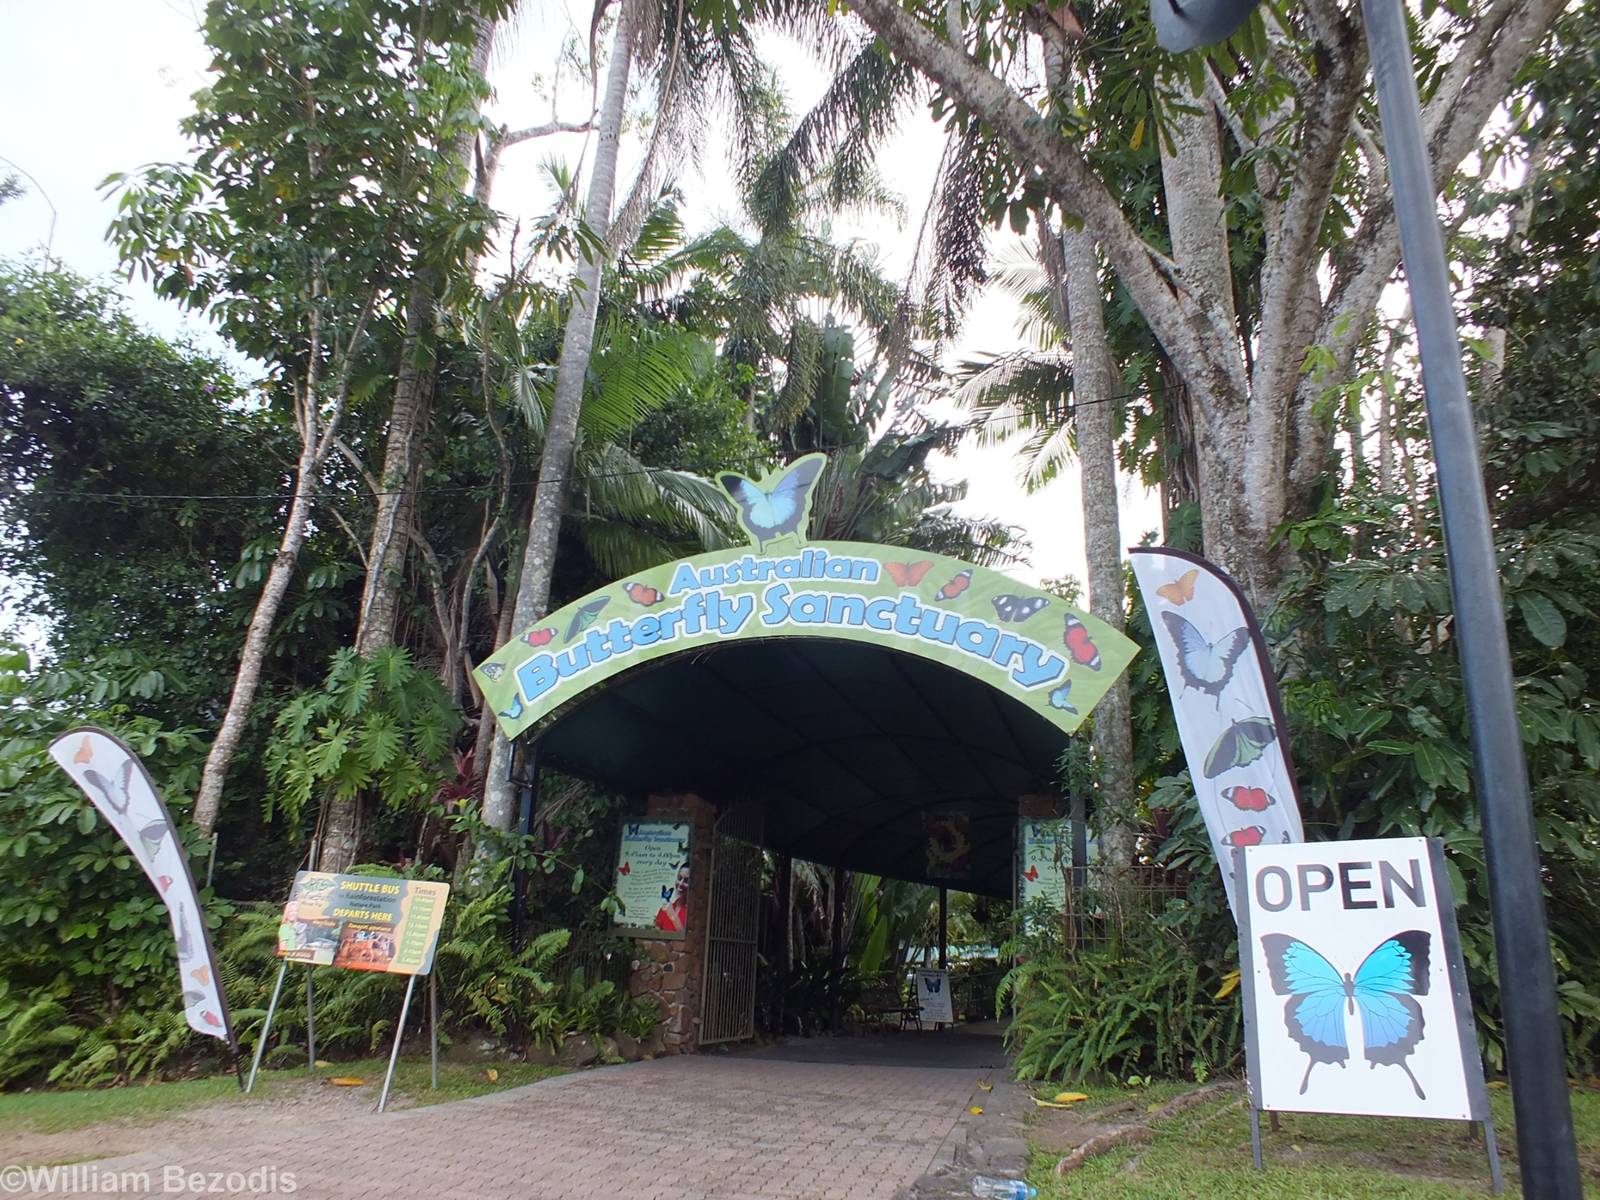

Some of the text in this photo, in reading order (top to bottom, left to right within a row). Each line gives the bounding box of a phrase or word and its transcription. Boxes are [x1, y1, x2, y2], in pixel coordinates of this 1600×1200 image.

[669, 550, 879, 595] Australian
[517, 584, 1065, 701] Butterfly Sanctuary
[340, 881, 381, 893] SHUTTLE
[381, 884, 400, 895] BUS
[1255, 859, 1427, 912] OPEN
[333, 908, 393, 921] DEPARTS HERE
